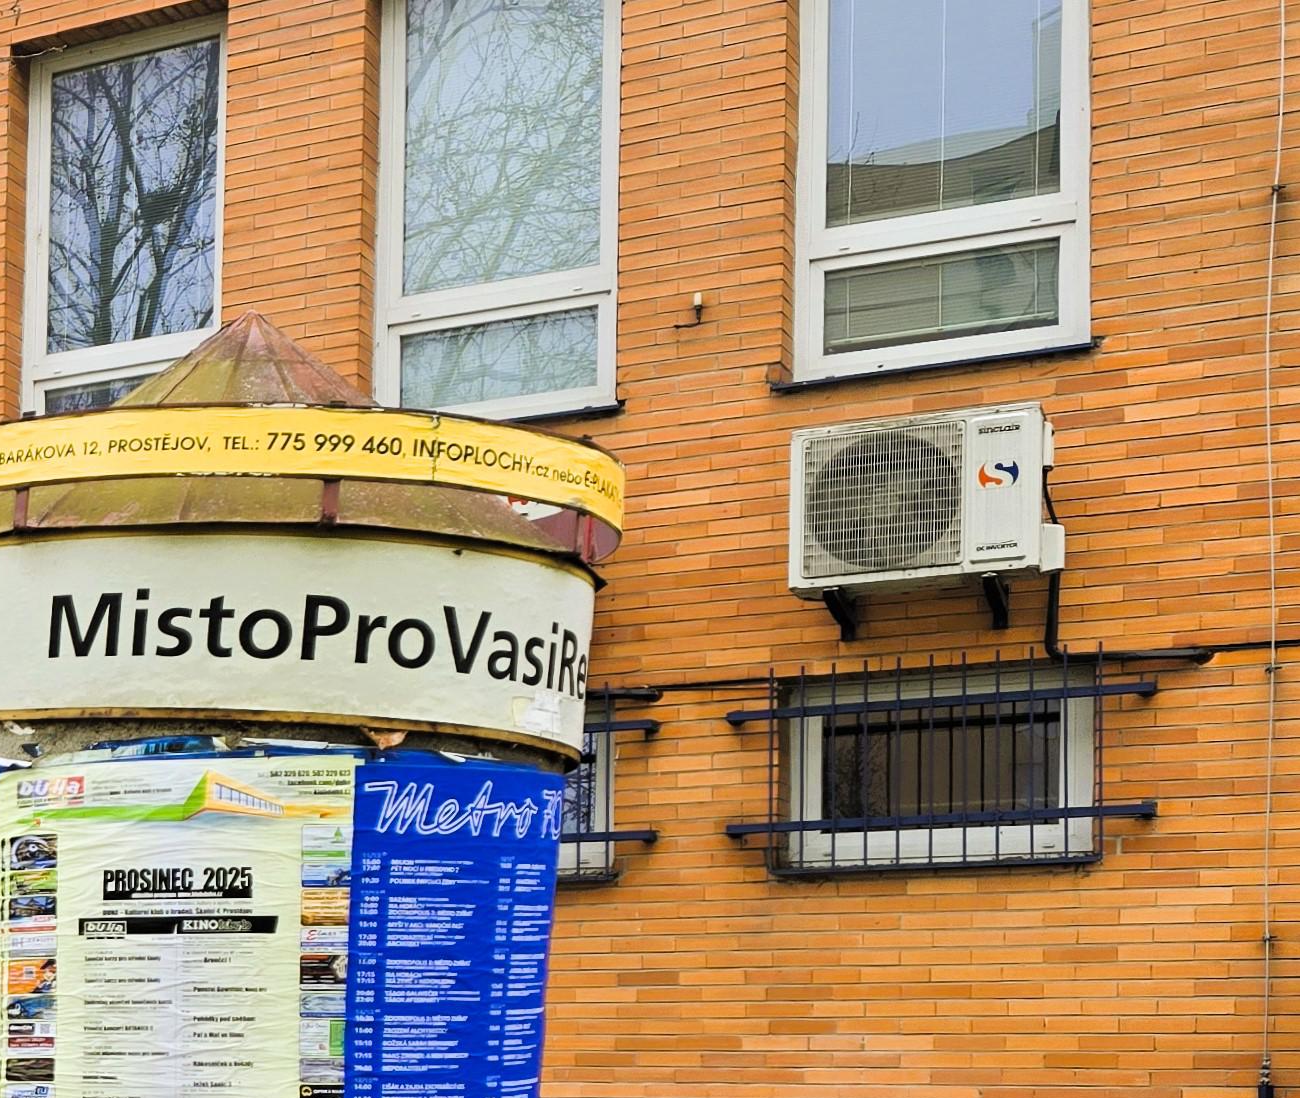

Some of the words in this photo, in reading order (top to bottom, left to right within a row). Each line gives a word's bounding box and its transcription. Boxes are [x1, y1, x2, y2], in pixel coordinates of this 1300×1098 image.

[81, 440, 103, 457] 12,
[107, 432, 212, 454] PROSTĚJOV,
[222, 435, 260, 452] TEL.:
[266, 431, 307, 452] 775
[313, 432, 356, 453] 999
[361, 435, 407, 459] 460,
[412, 437, 550, 479] INFOPLOCHY.cz
[551, 467, 583, 488] nebo
[364, 780, 539, 839] Metro
[103, 868, 194, 893] PROSINEC
[203, 866, 252, 892] 2025
